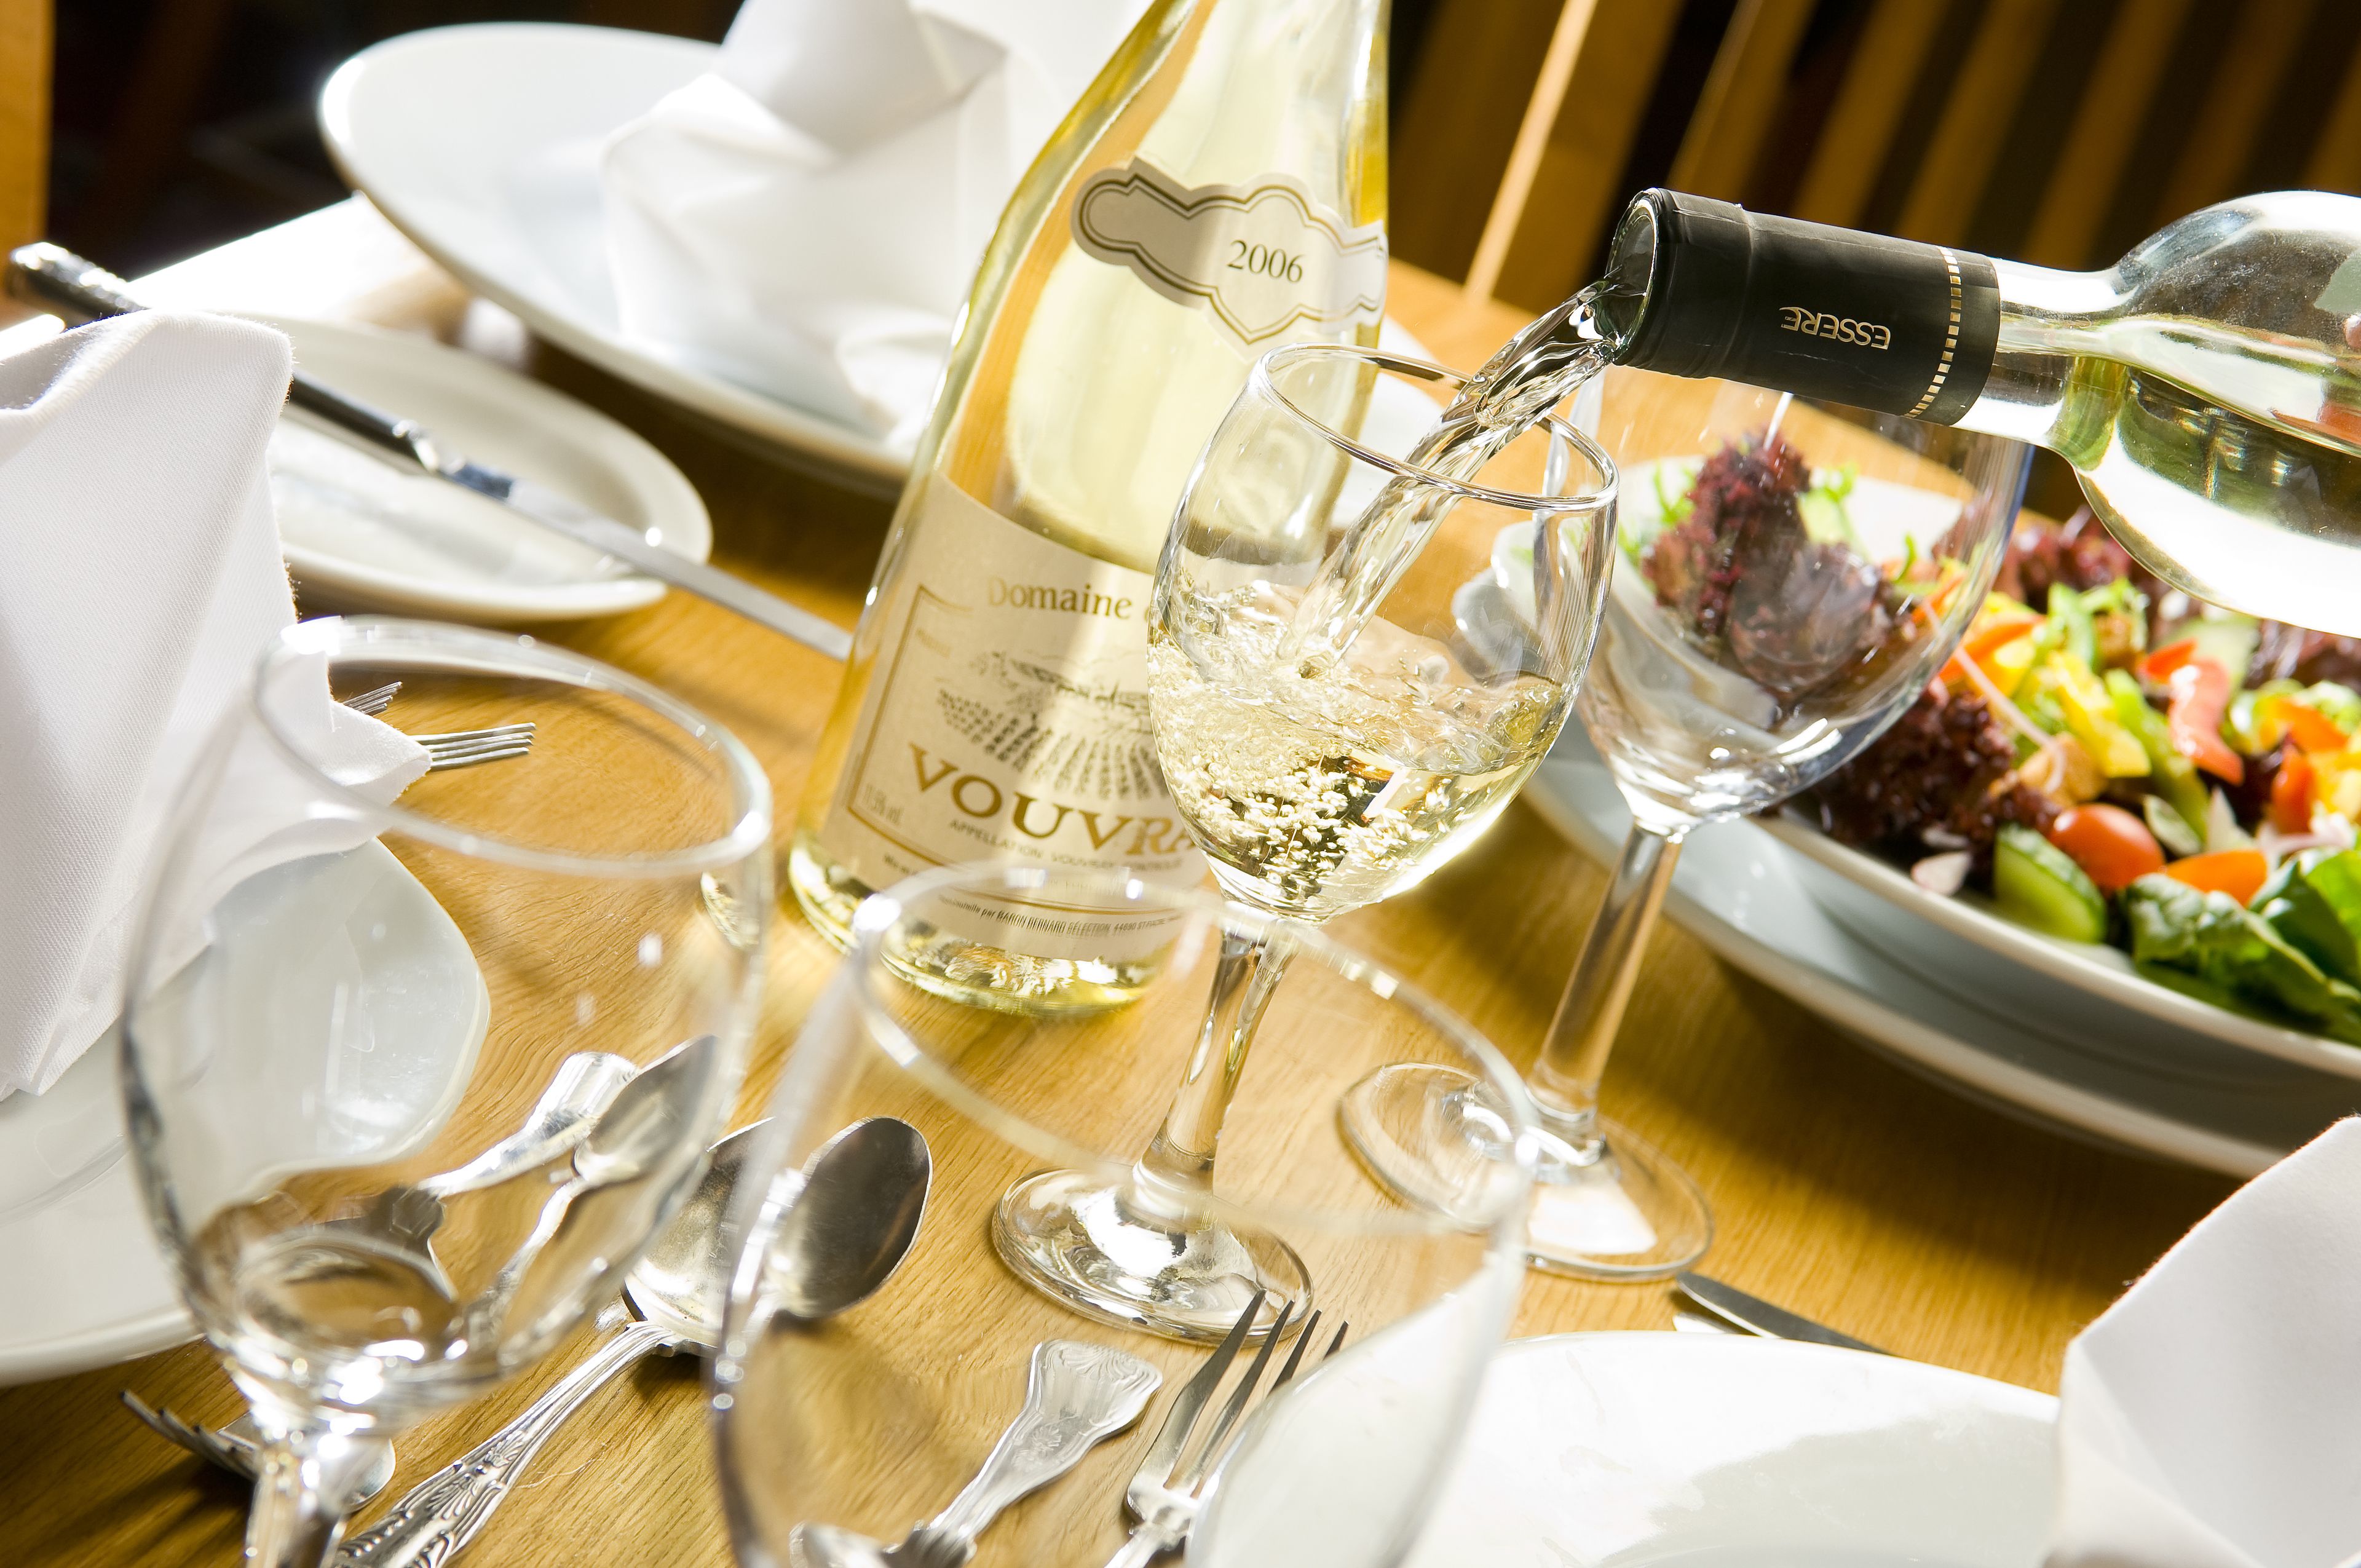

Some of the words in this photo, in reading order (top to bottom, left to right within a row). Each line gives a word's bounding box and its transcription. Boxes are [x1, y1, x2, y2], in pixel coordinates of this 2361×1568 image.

[1227, 239, 1307, 284] 2006
[1779, 306, 1892, 350] ESSERE
[987, 576, 1133, 620] Domaine
[908, 742, 1196, 856] VOUVRA
